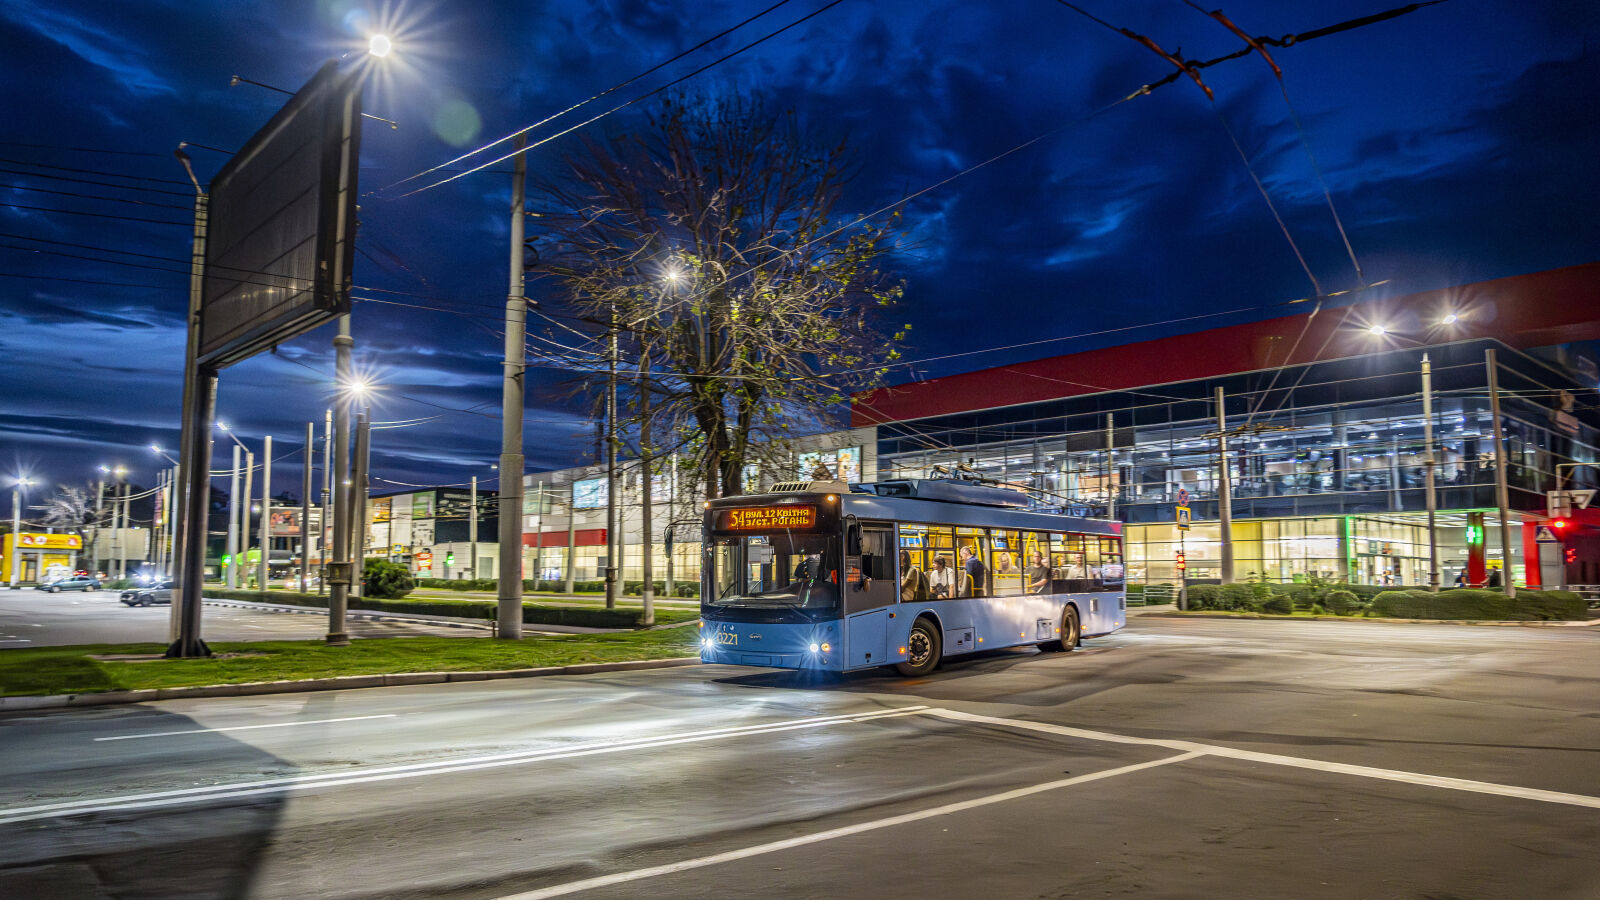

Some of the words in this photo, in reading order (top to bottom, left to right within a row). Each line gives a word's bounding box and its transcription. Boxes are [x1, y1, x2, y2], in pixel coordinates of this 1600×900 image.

[765, 510, 776, 518] 12
[731, 511, 745, 527] 54
[772, 517, 809, 525] РОГАНЬ
